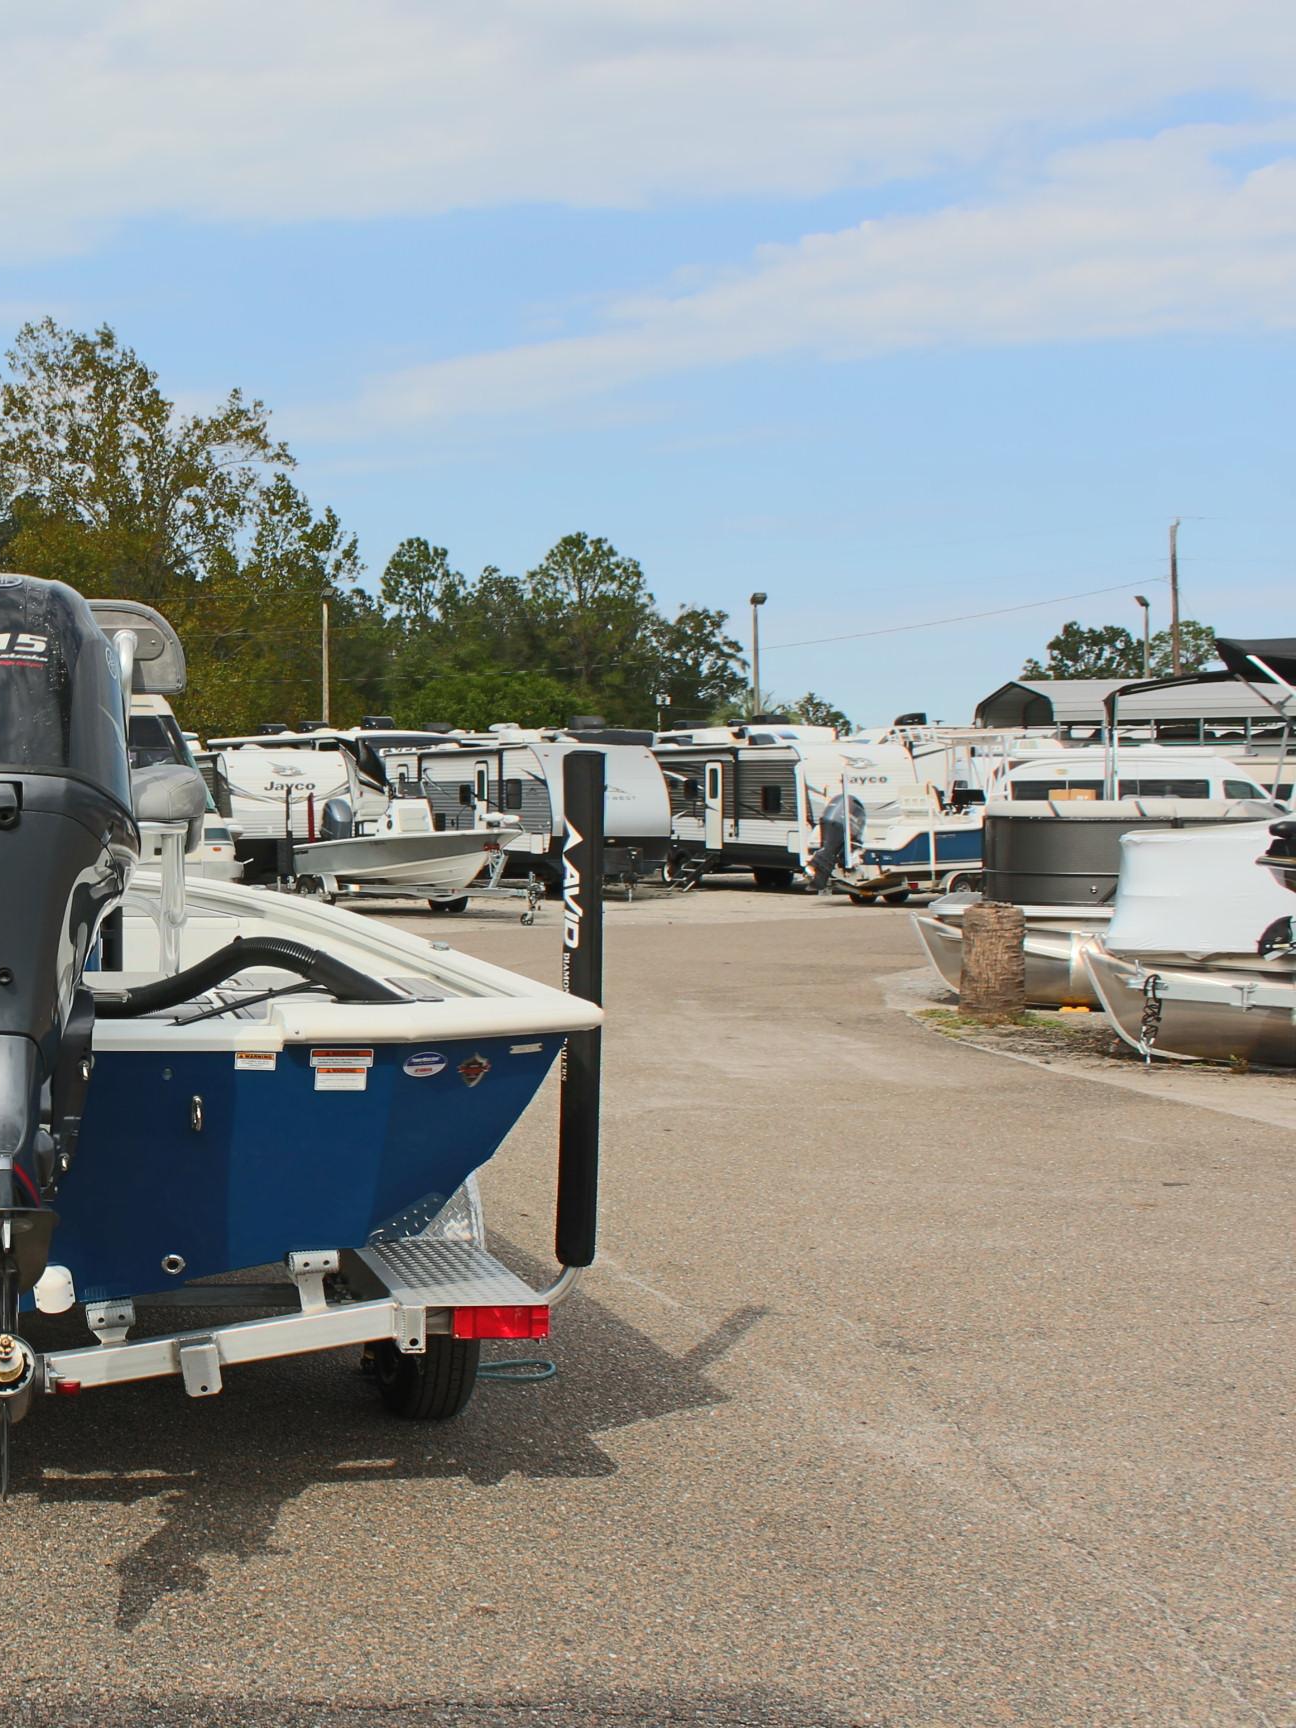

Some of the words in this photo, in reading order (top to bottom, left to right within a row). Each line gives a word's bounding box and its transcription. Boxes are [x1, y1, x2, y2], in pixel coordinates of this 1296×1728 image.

[840, 774, 888, 786] ayco
[264, 781, 316, 792] Jayco
[562, 853, 584, 949] AVID
